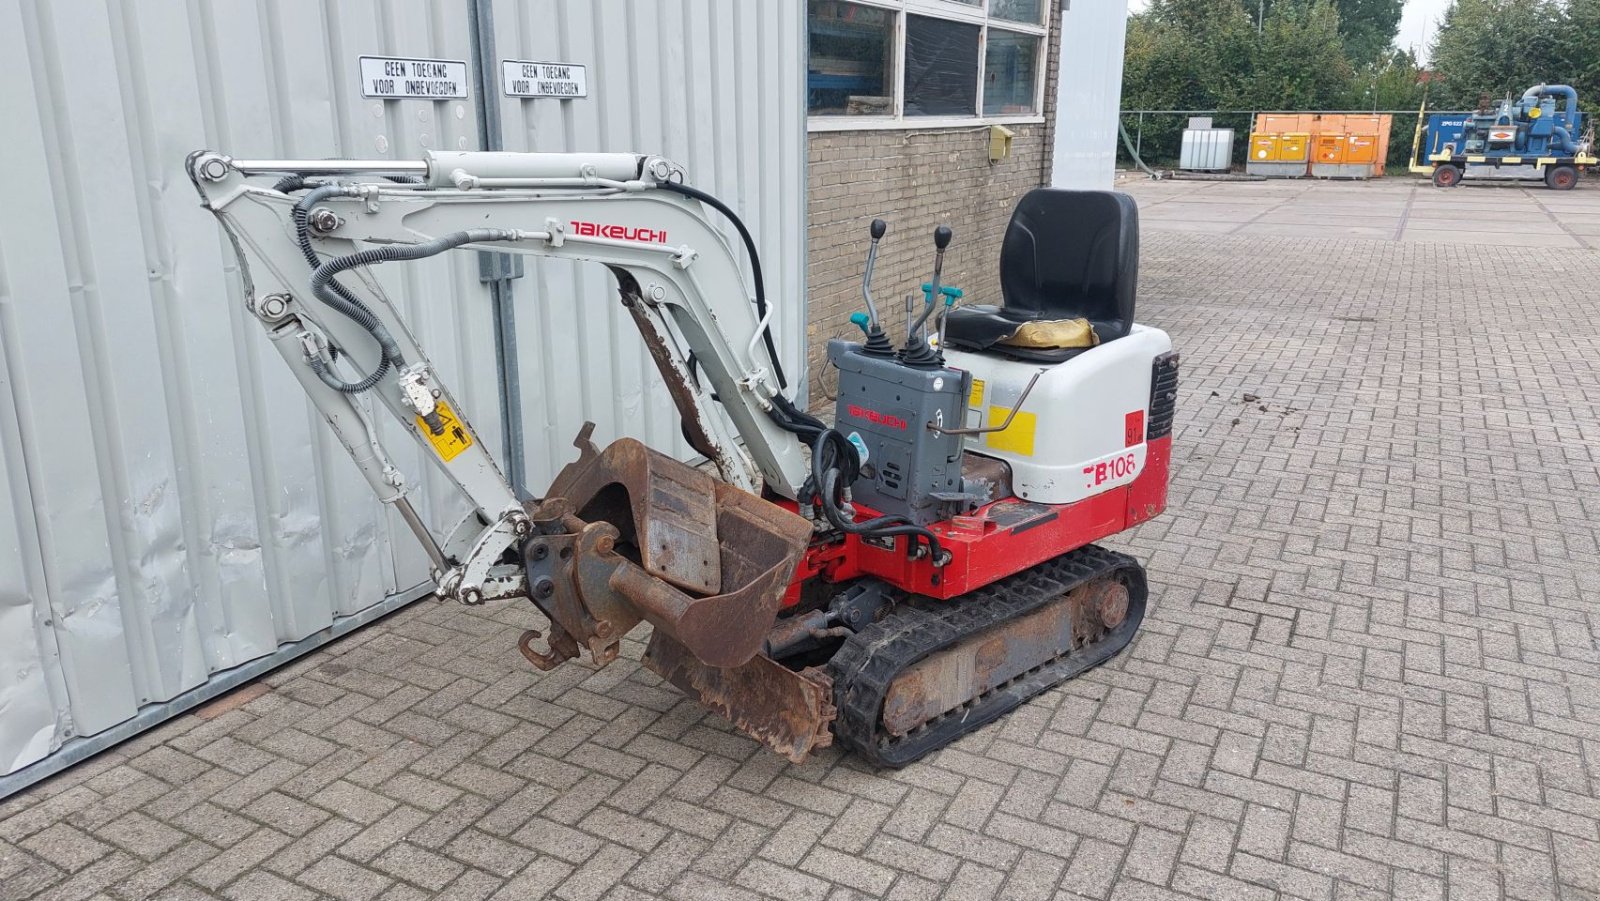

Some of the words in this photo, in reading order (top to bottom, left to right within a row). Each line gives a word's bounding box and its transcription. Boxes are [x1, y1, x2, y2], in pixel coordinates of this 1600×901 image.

[384, 61, 406, 77] GEEN
[412, 62, 447, 78] TOEGANG
[522, 64, 538, 79] GEEN
[542, 66, 571, 80] TOEGANG
[373, 79, 394, 94] VOOR
[405, 80, 457, 95] ONBEVOEGDEN
[512, 80, 530, 93] VOOR
[537, 81, 579, 95] ONBEVOEGDEN
[570, 221, 667, 243] TAKEUCHI
